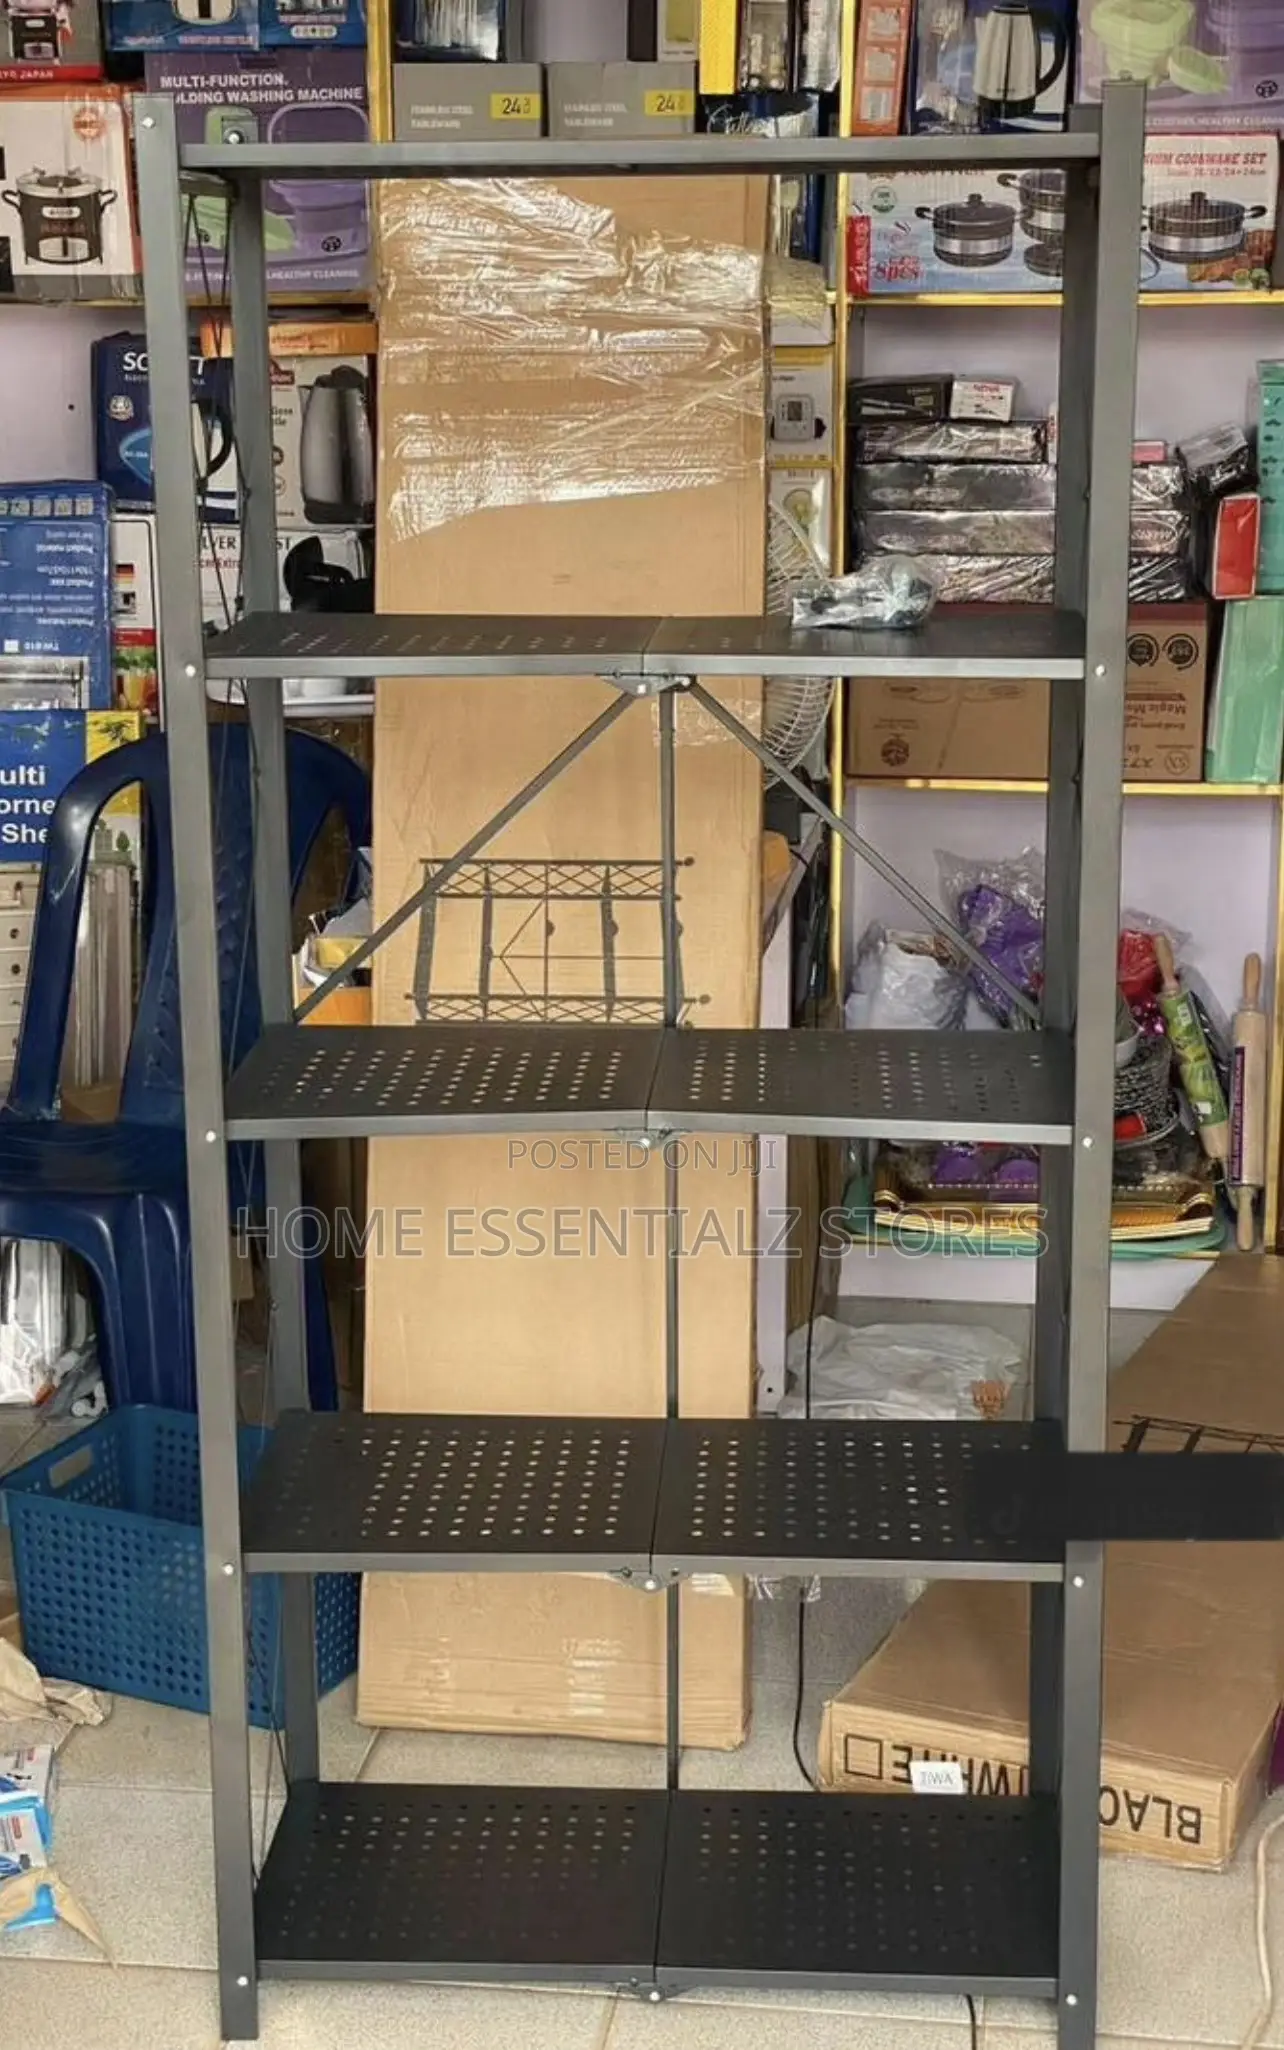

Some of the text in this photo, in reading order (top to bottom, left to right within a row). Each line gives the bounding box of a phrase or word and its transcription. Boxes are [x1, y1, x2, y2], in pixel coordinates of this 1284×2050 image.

[176, 86, 363, 104] LDING WASHING MACHINE
[656, 93, 676, 112] 24
[501, 96, 522, 115] 24
[1242, 152, 1268, 165] SET
